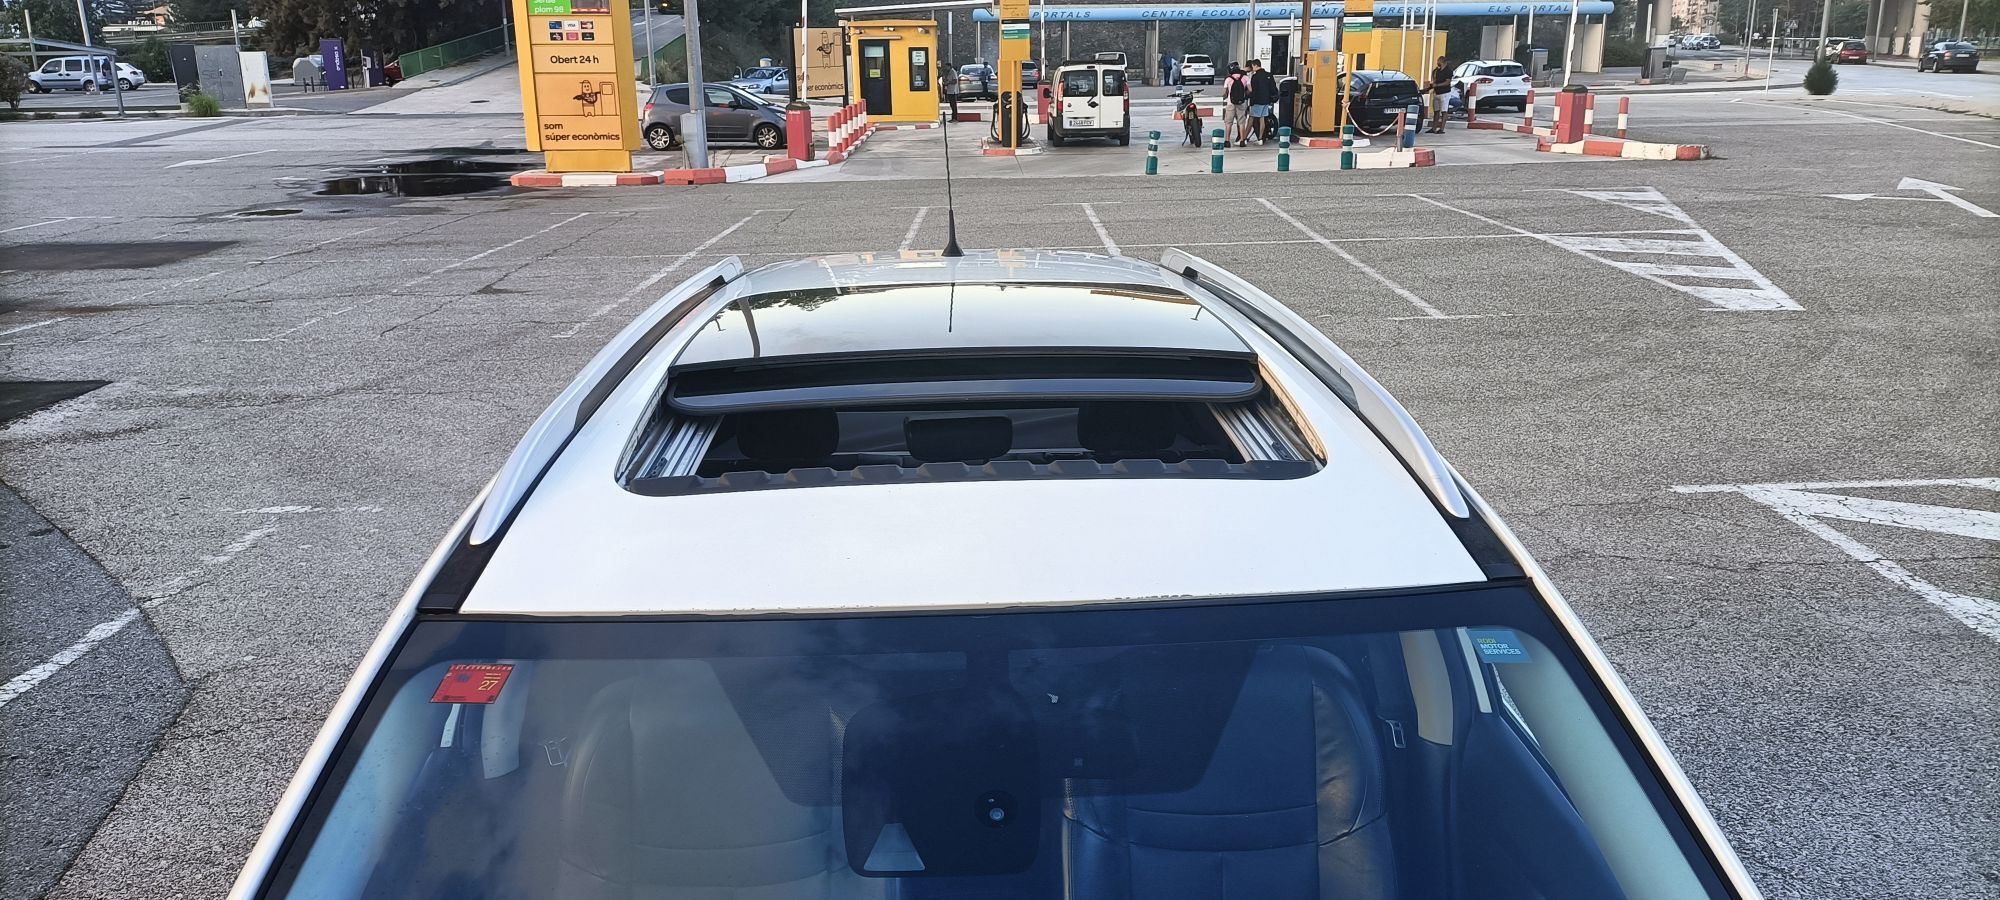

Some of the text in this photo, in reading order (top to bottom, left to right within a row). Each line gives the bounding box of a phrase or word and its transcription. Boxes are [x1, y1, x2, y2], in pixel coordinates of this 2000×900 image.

[534, 6, 553, 15] plom
[1141, 9, 1195, 18] CENTRE
[1488, 5, 1512, 13] ELS
[550, 55, 599, 64] Obert 24 h
[545, 132, 620, 142] súper econòmics
[478, 680, 499, 691] 27
